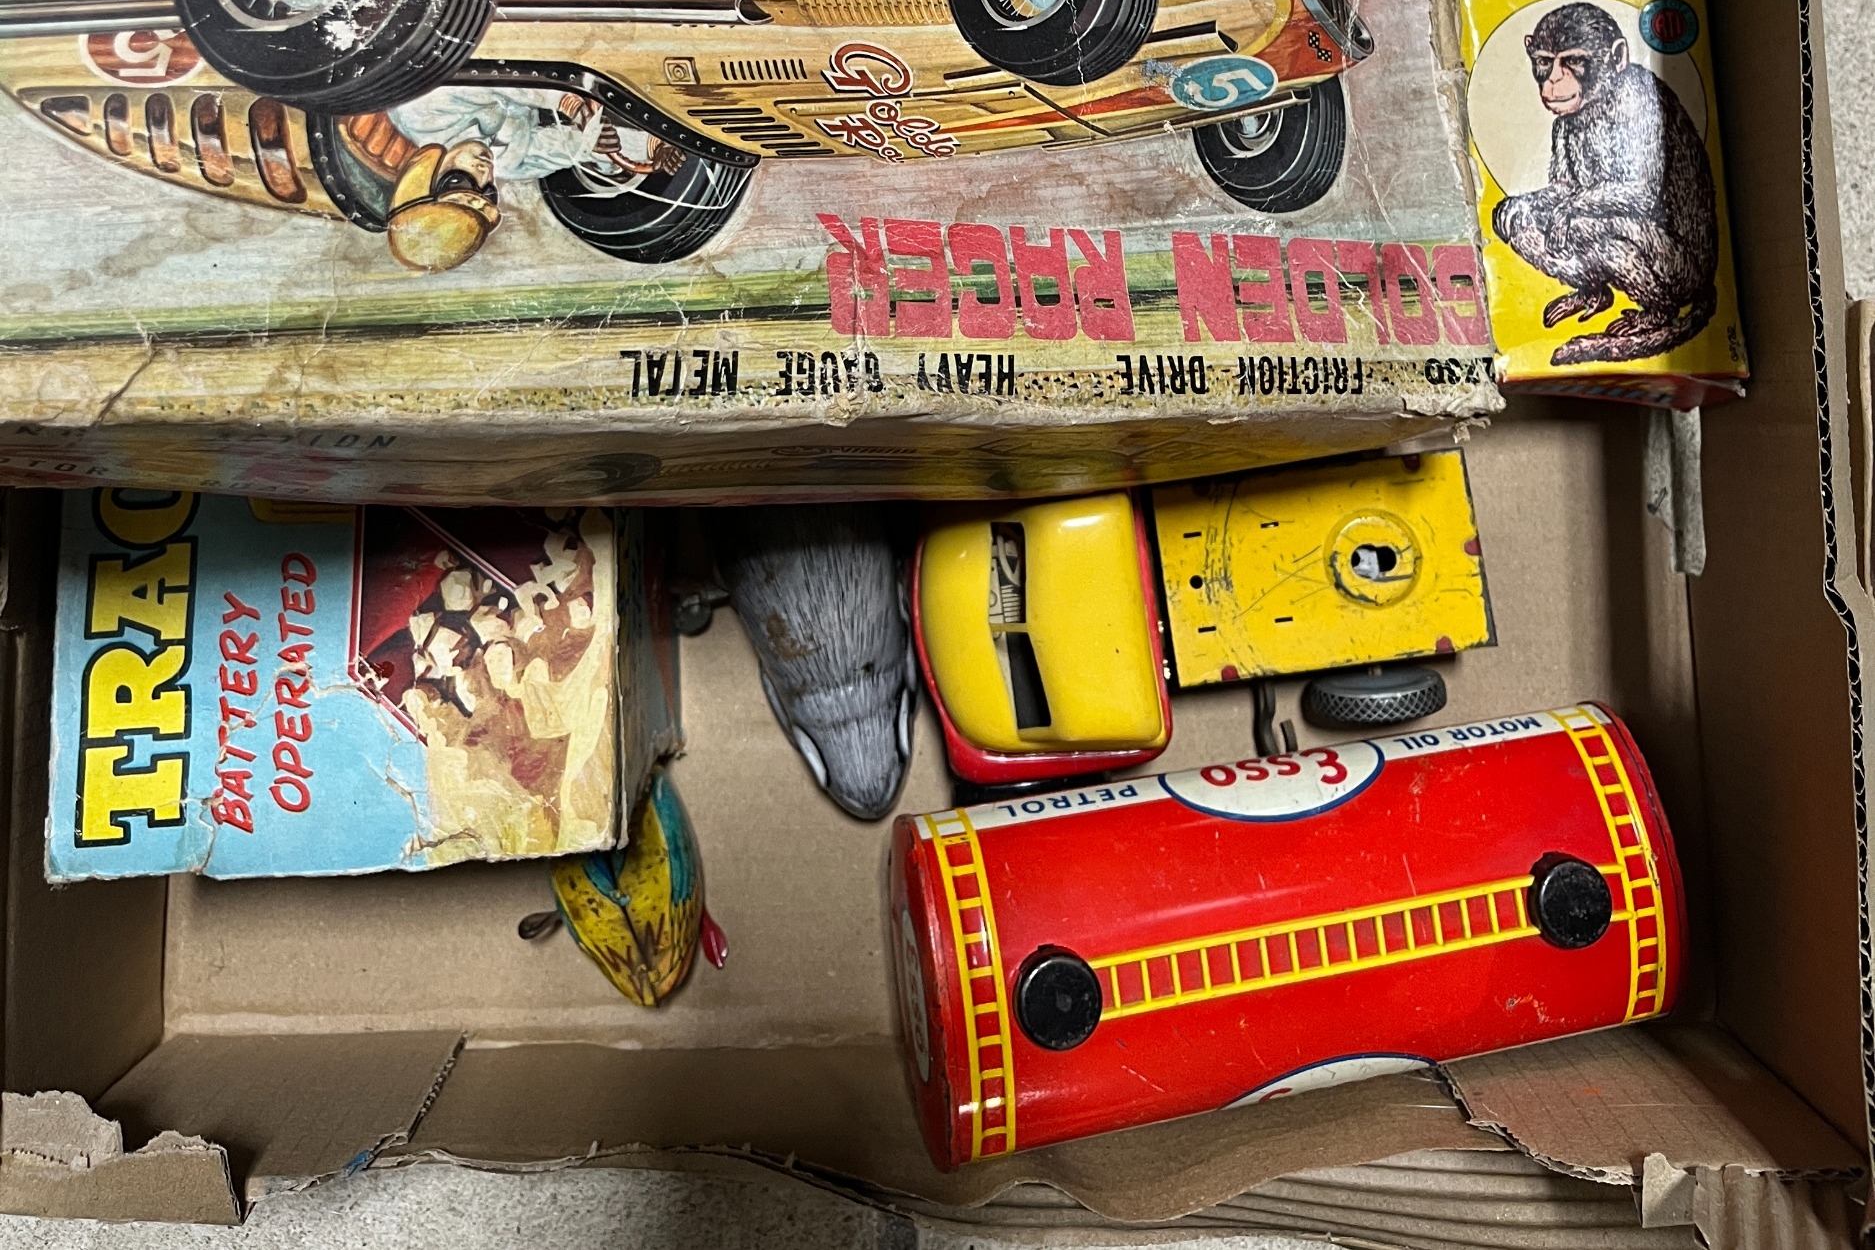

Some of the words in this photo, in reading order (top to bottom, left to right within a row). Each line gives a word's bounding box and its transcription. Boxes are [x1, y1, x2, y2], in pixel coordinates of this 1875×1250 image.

[1184, 66, 1256, 108] 5
[817, 212, 1134, 342] RACER
[1173, 231, 1486, 345] GOLDEN
[621, 349, 738, 398] METAL
[776, 351, 883, 394] GAUGE
[918, 353, 1014, 394] HEAVY
[1120, 355, 1205, 394] DRIVE
[1241, 356, 1364, 396] FRICTION
[269, 553, 318, 814] OPERATED
[213, 592, 262, 834] BATTERY
[1449, 715, 1541, 741] MOTOR
[1394, 733, 1438, 751] OIL
[997, 784, 1137, 817] PETROL
